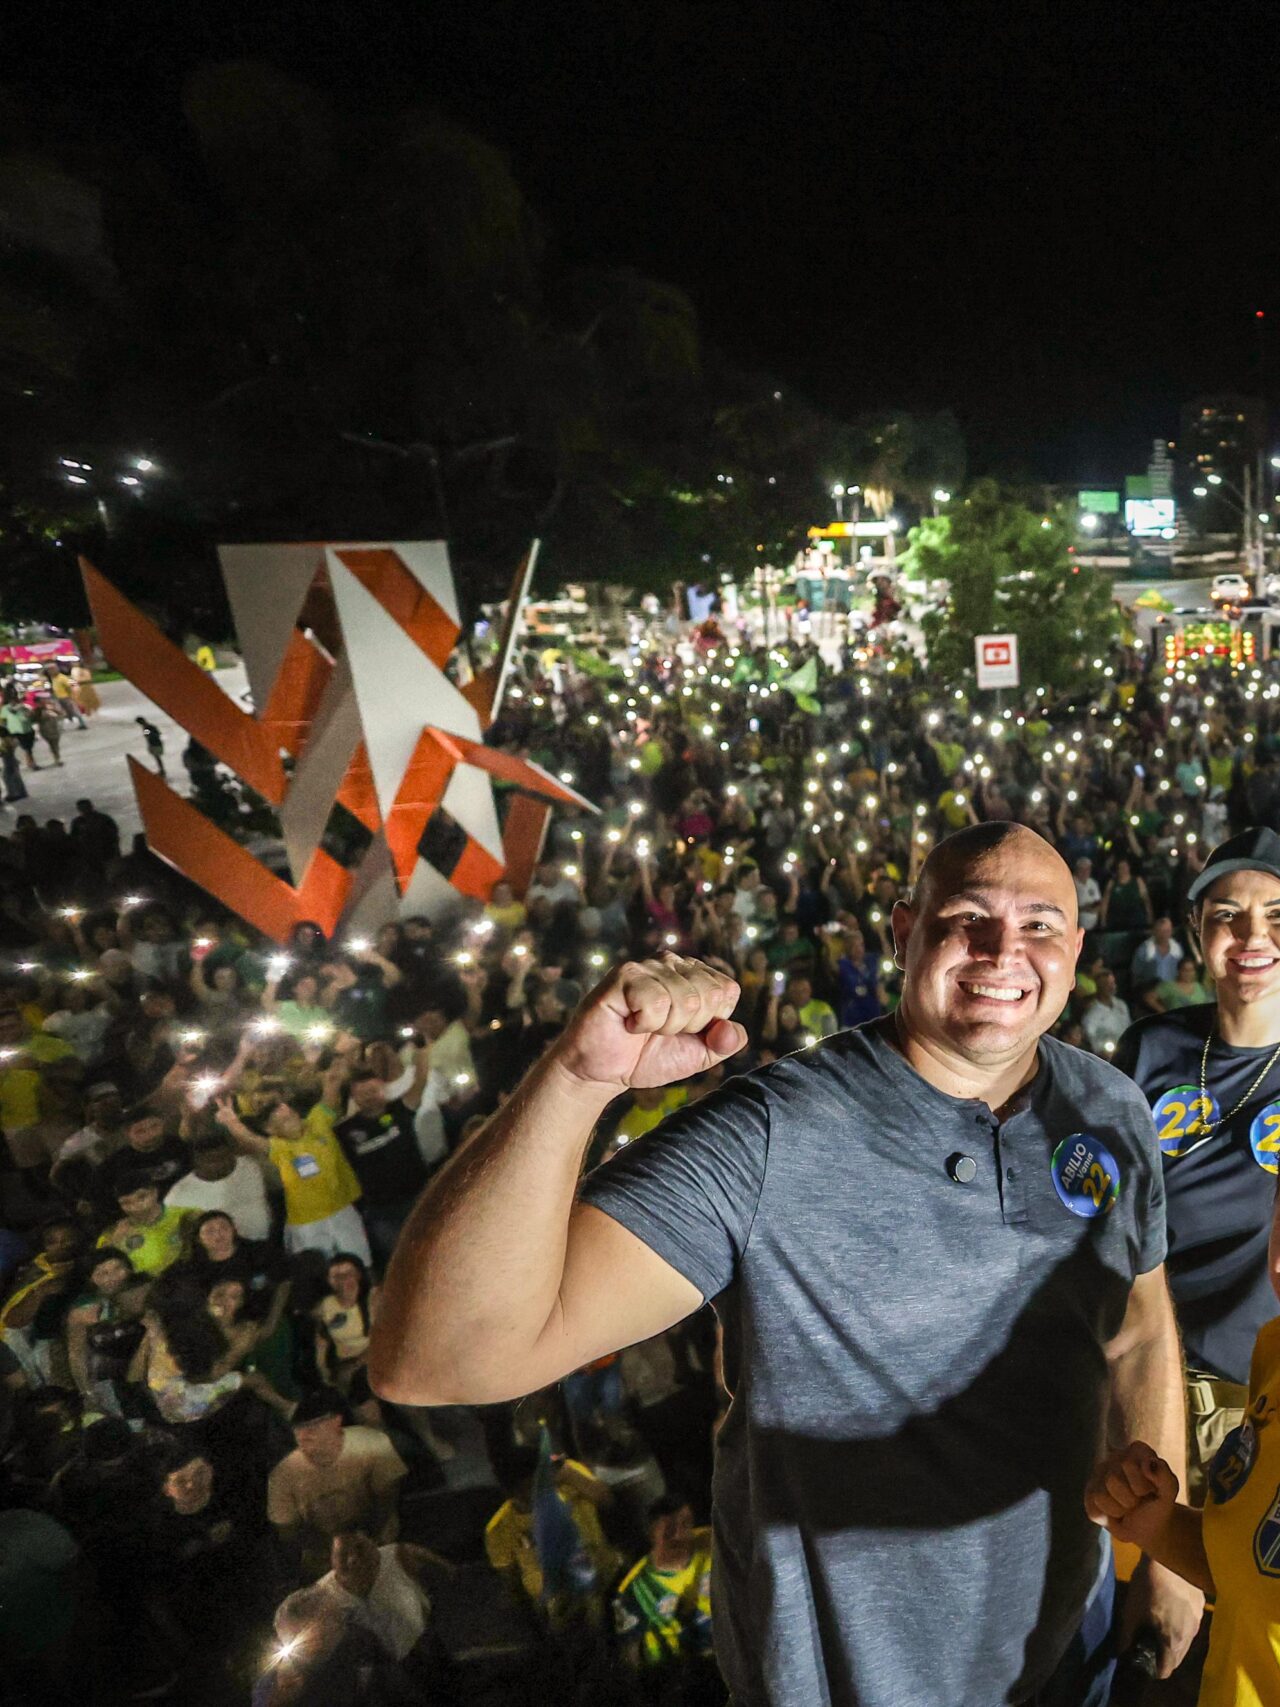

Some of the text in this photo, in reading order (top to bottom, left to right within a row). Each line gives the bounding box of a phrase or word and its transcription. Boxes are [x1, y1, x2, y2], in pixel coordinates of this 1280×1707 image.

[1159, 1097, 1214, 1140] 22
[1061, 1142, 1087, 1190] ABILIO
[1082, 1162, 1111, 1208] 22
